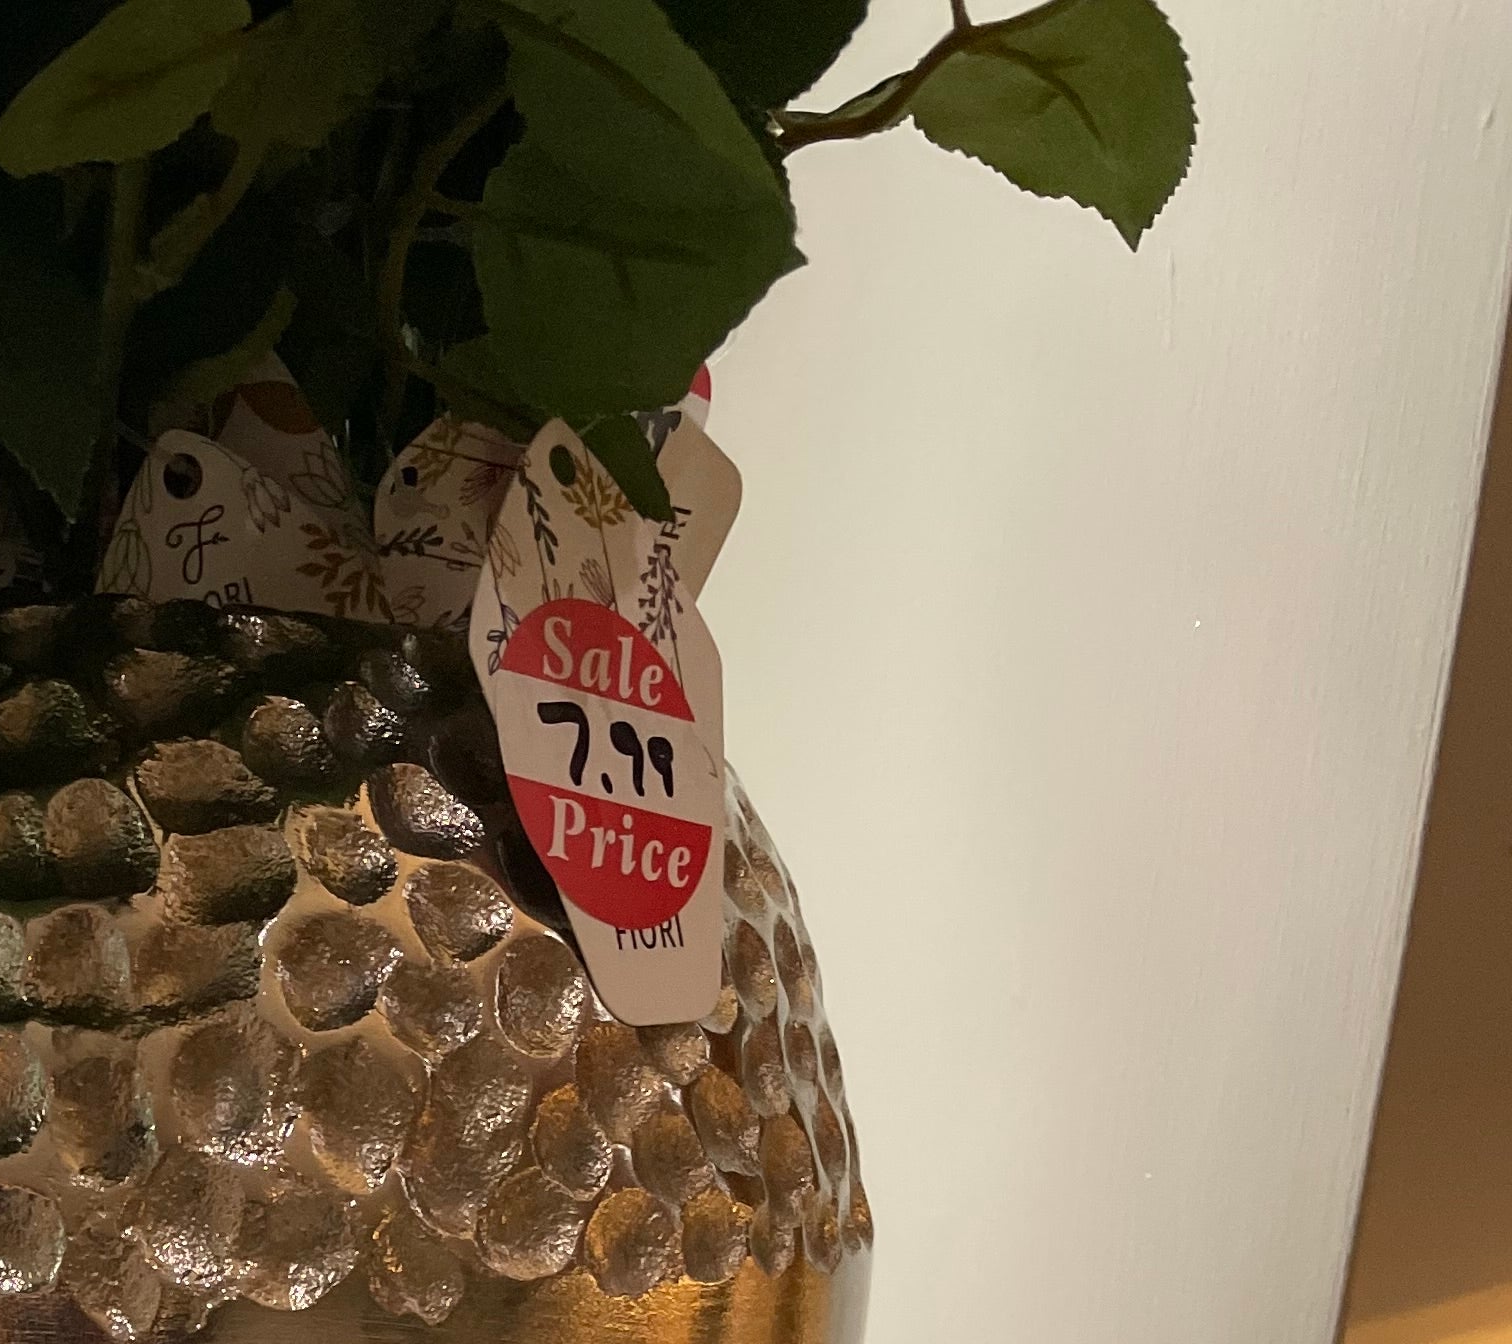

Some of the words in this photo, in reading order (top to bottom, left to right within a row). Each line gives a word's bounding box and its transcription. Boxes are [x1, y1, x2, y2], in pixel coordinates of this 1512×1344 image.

[542, 617, 665, 706] Sale
[536, 701, 674, 798] 7.99
[545, 794, 691, 886] Price
